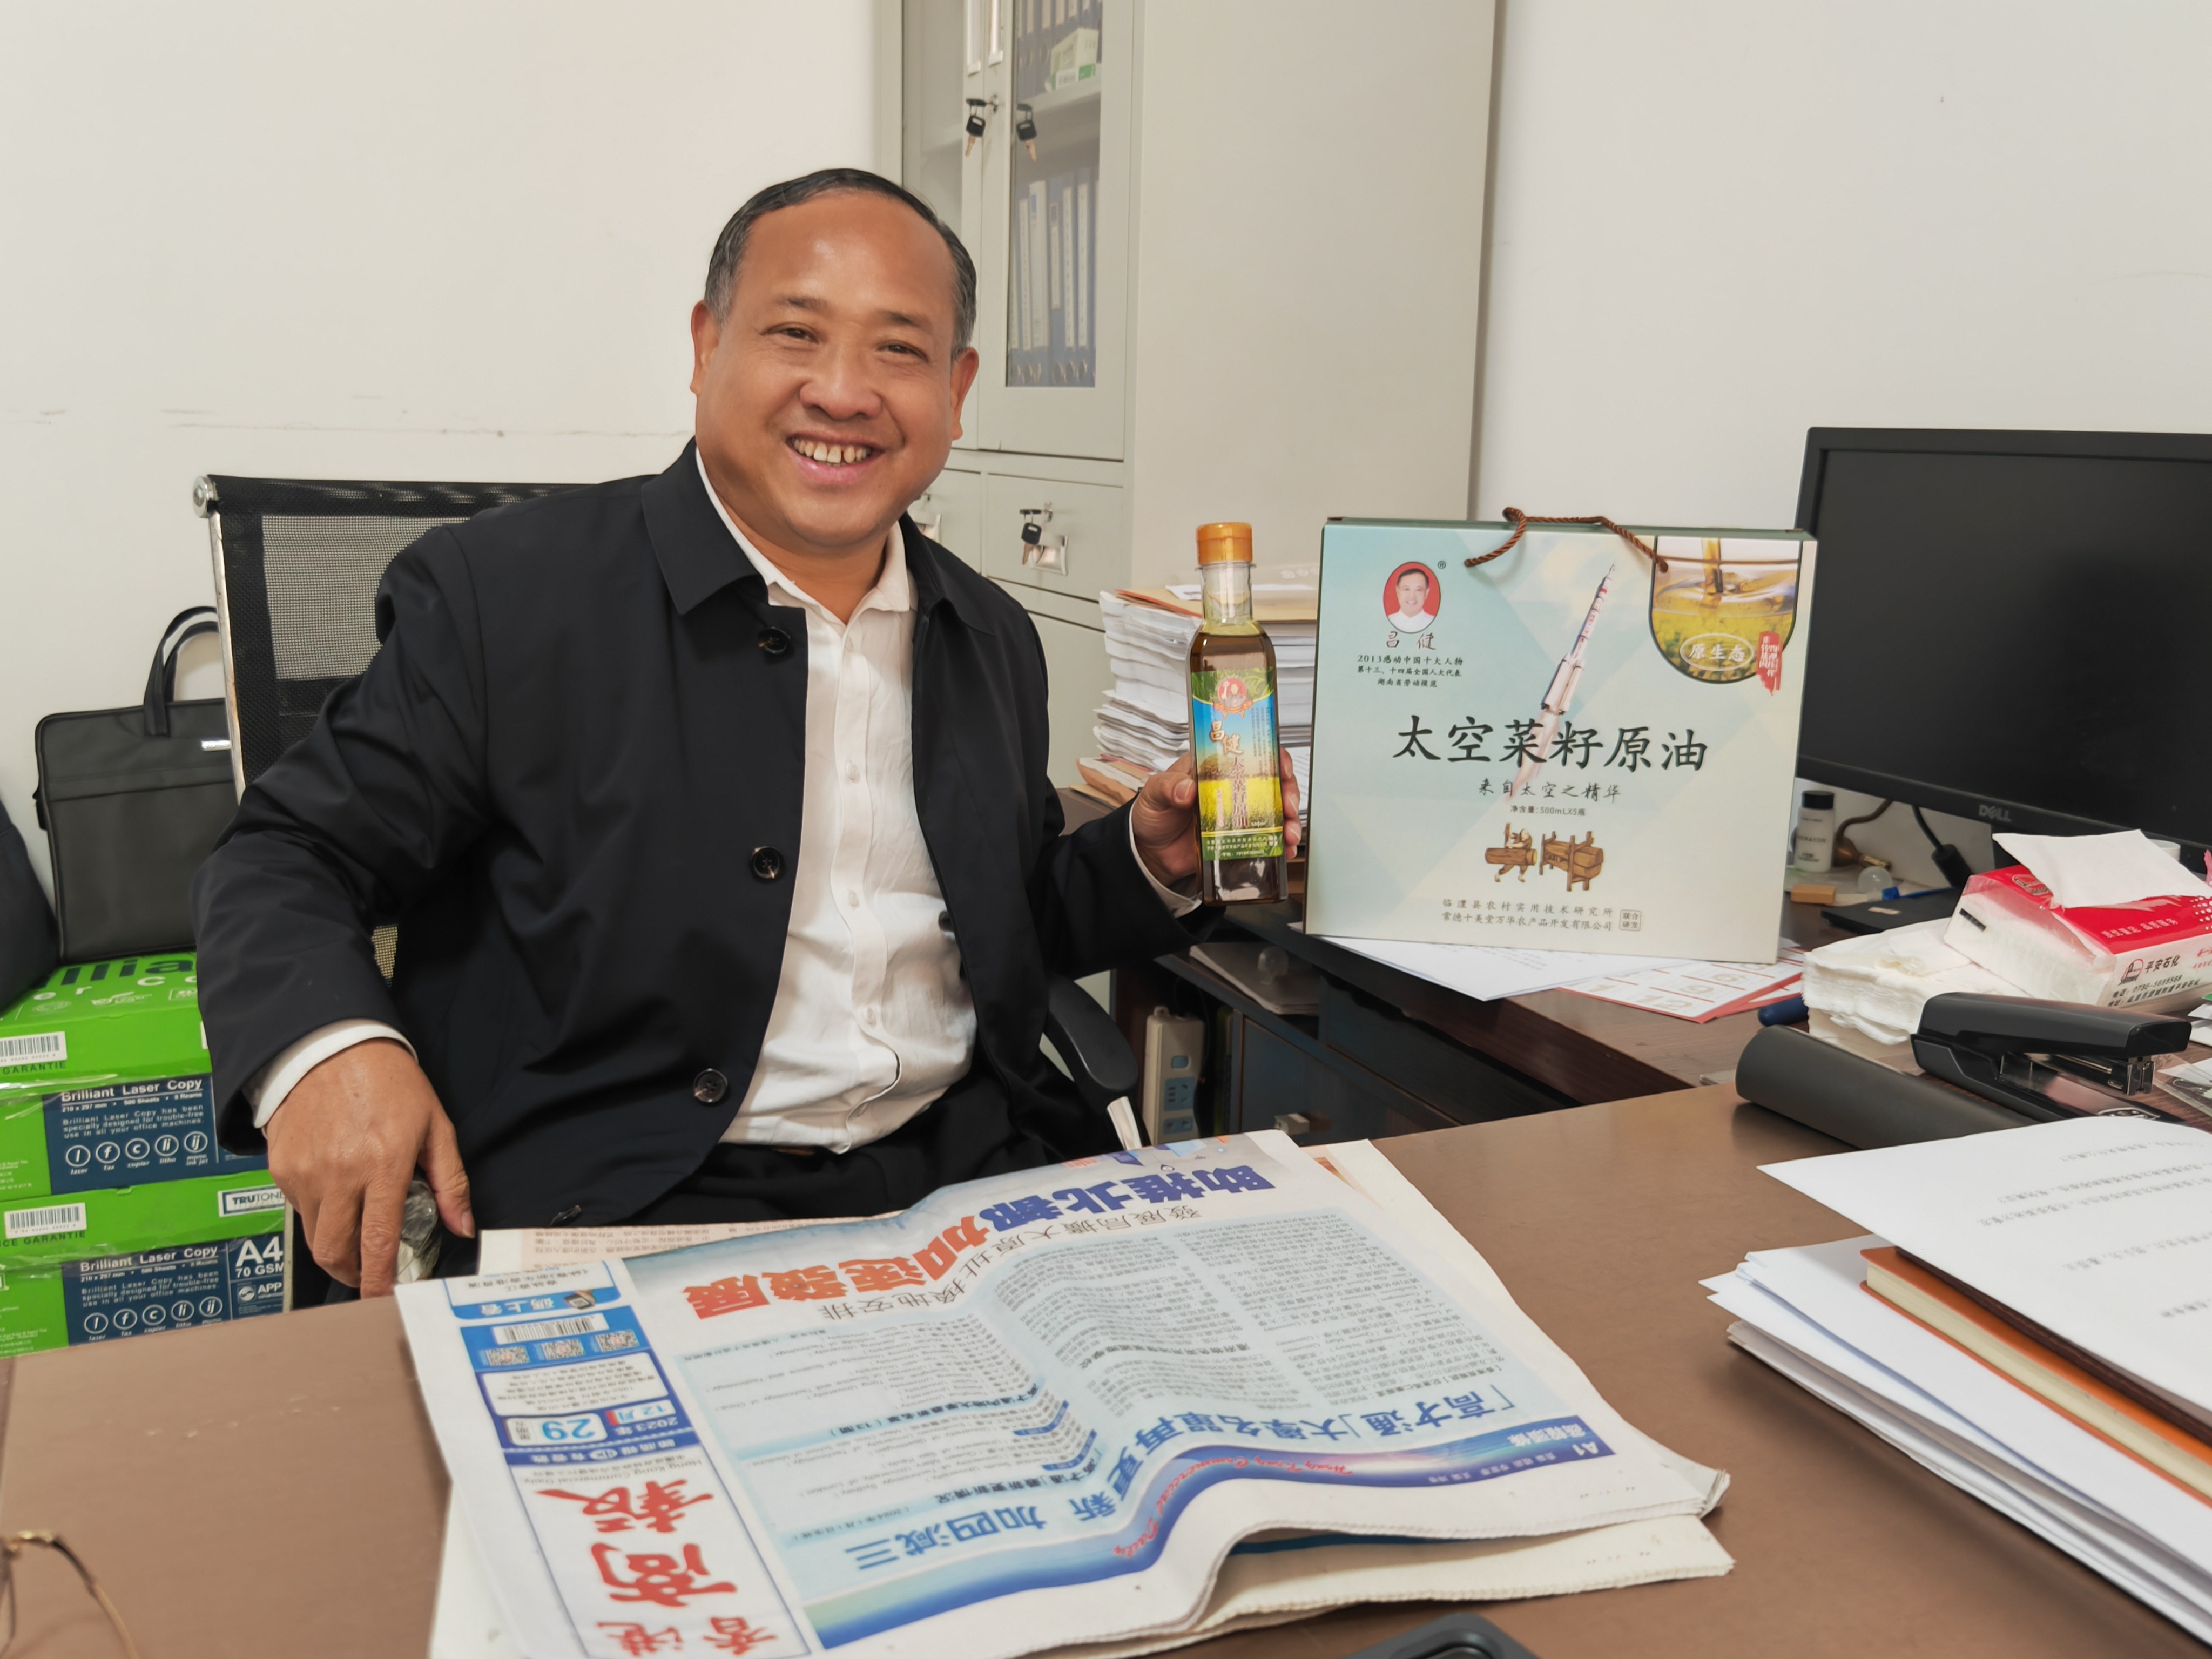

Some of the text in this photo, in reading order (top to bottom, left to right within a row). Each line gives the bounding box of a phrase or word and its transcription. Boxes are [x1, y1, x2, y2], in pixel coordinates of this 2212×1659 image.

[1357, 655, 1463, 666] 2013感动中国十大人物
[1688, 642, 1745, 663] 原生态
[1377, 678, 1438, 688] 湖南省劳动模范
[1392, 714, 1709, 773] 太空菜籽原油
[1479, 778, 1621, 804] 来自太空之精华
[1979, 805, 2011, 822] DELL
[1442, 899, 1613, 918] 临澧县农村实用技术研究所
[1442, 912, 1612, 932] 常德十美堂万华农产品开发有限公司
[3, 1061, 66, 1075] GARANTIE
[61, 1079, 203, 1102] Brilliant Laser Copy
[63, 1116, 99, 1126] Brilliant
[105, 1112, 129, 1121] Laser
[134, 1109, 157, 1118] Copy
[162, 1106, 177, 1115] has
[111, 1127, 129, 1135] your
[24, 1231, 86, 1245] GARANTIE
[683, 1164, 1276, 1320] 助推北都加速發展
[80, 1245, 218, 1272] Brilliant Laser Copy
[235, 1236, 284, 1268] A4
[235, 1262, 284, 1279] 70 GSM
[822, 1205, 1203, 1323] 發展局擴大原址換地安排
[82, 1285, 117, 1295] Brilliant
[122, 1280, 146, 1289] Laser
[152, 1277, 173, 1285] Copy
[258, 1282, 282, 1294] APP
[617, 1405, 667, 1421] 12月
[541, 1418, 595, 1441] 29
[615, 1417, 678, 1436] 2023年
[1571, 1440, 1600, 1456] A1
[633, 1466, 666, 1477] Kong
[668, 1460, 702, 1470] Hong
[1253, 1456, 1302, 1474] Kong
[1304, 1460, 1353, 1476] Hong
[558, 1471, 631, 1484] Commercial
[845, 1505, 1047, 1571] 加四減三
[1112, 1515, 1163, 1559] Daily
